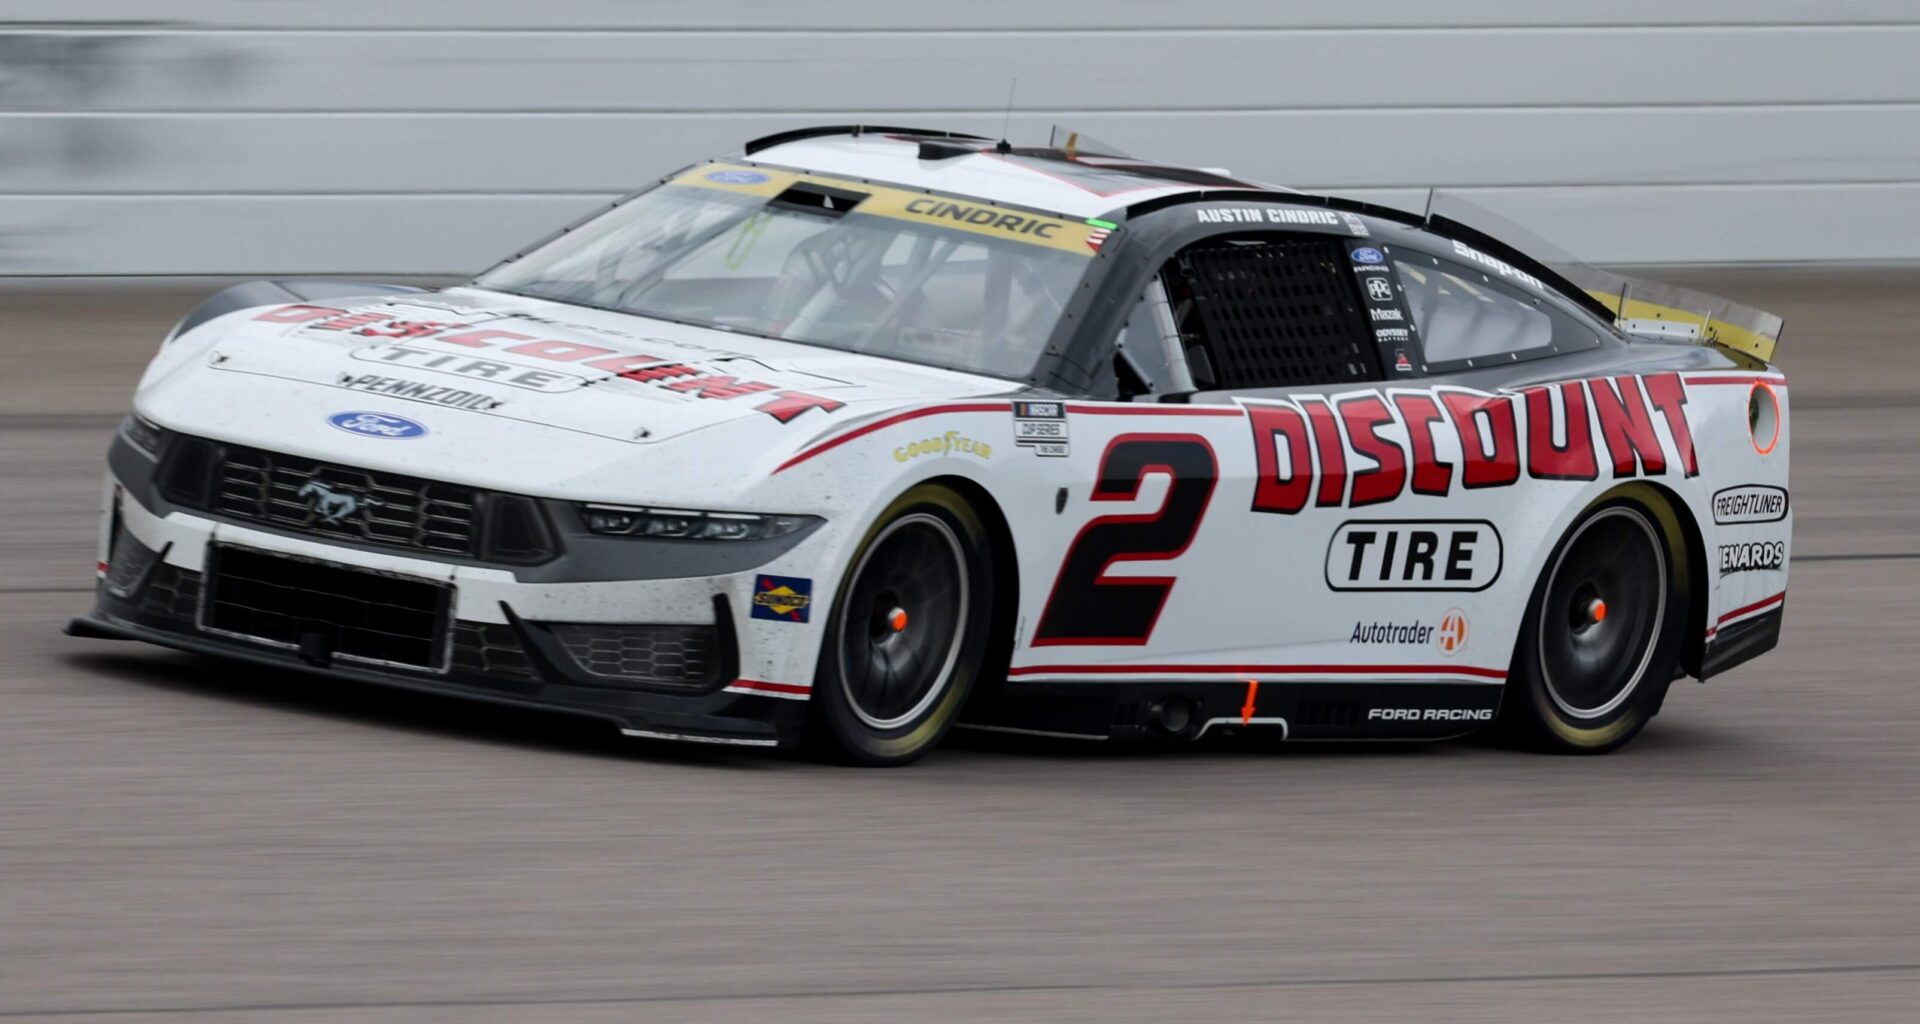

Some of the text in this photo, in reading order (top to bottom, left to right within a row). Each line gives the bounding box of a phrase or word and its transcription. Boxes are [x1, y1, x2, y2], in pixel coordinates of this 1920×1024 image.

[904, 198, 1062, 240] CINDRIC
[1197, 208, 1263, 223] AUSTIN
[1266, 208, 1338, 225] CINDRIC
[1369, 280, 1390, 298] PPG
[1370, 308, 1403, 321] Mazak
[1376, 328, 1408, 337] ODYSSEY
[252, 304, 846, 425] DISCOUNT
[382, 346, 565, 388] TIRE
[352, 374, 496, 410] PENNZOIL
[341, 413, 414, 437] Ford
[1244, 373, 1700, 515] DISCOUNT
[1716, 494, 1783, 516] FREIGHTLINER
[1031, 432, 1218, 647] 2
[1346, 531, 1478, 581] TIRE
[1350, 620, 1434, 644] Autotrader
[1368, 708, 1493, 720] FORD RACING
